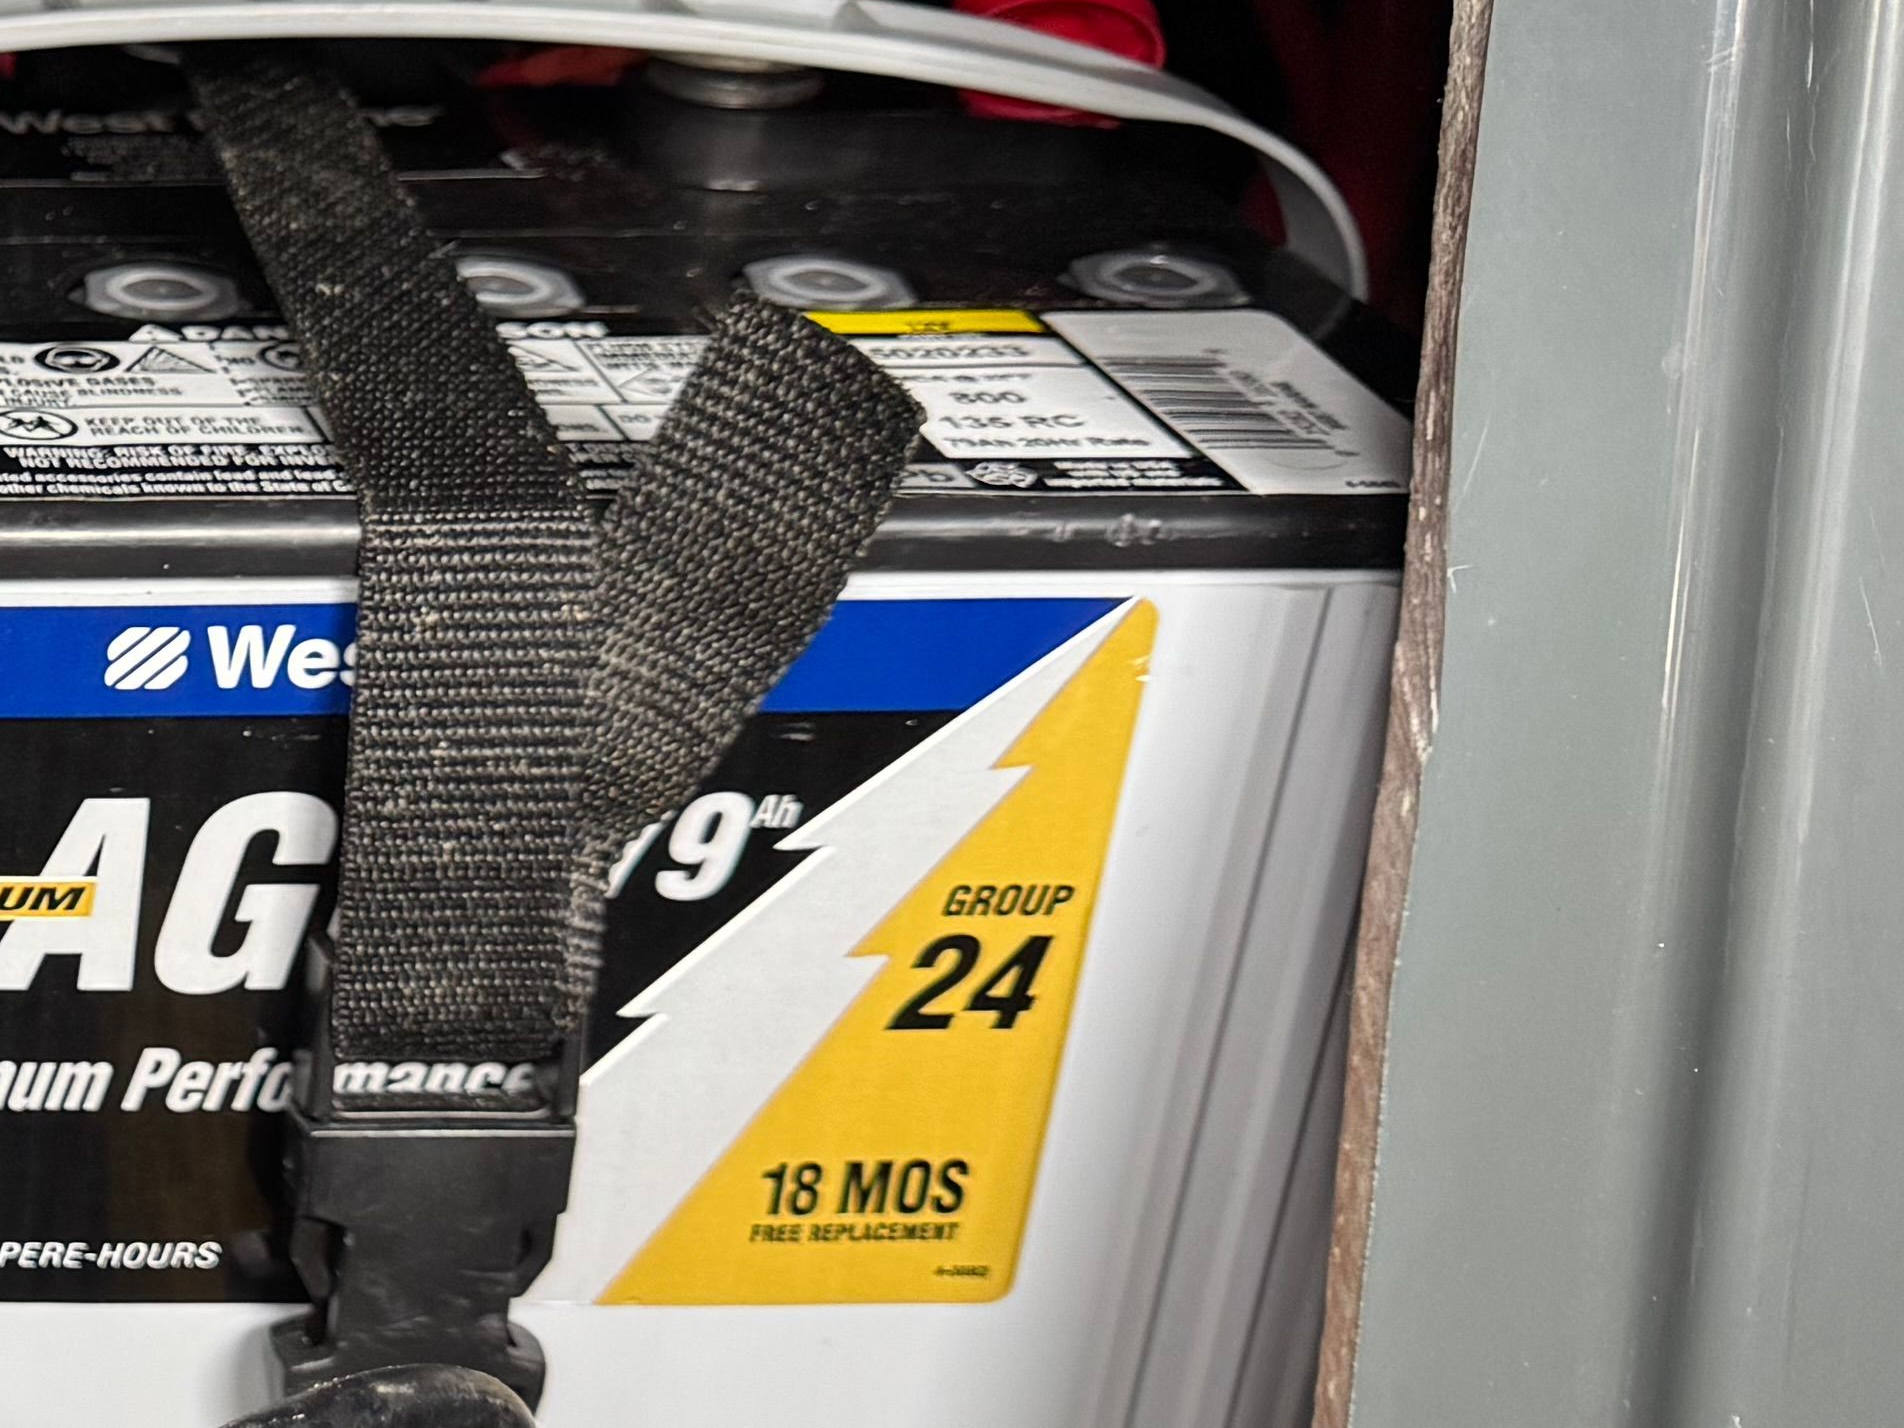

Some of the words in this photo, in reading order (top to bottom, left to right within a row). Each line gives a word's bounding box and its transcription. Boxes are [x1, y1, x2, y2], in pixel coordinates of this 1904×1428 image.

[943, 883, 1076, 918] GROUP
[884, 932, 1055, 1032] 24
[762, 1161, 824, 1216] 18
[837, 1159, 971, 1216] MOS
[750, 1223, 801, 1243] FREE
[808, 1221, 960, 1243] REPLACEMENT
